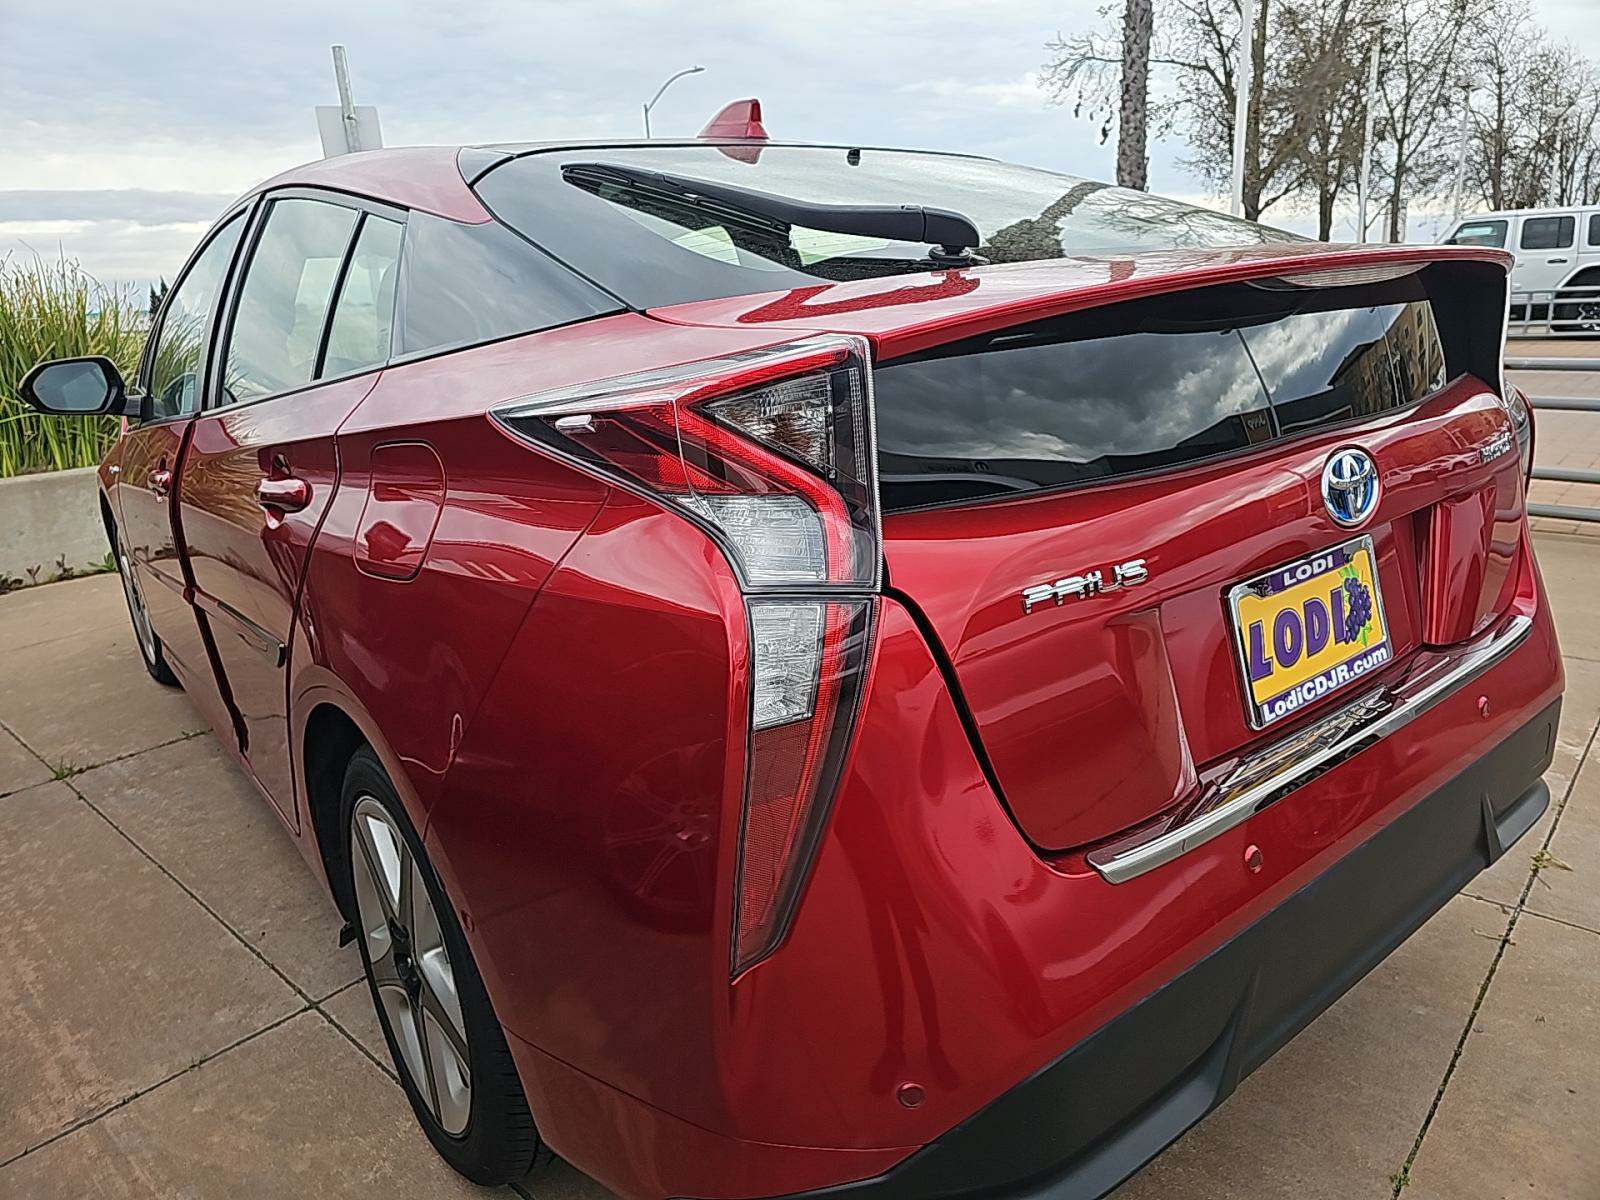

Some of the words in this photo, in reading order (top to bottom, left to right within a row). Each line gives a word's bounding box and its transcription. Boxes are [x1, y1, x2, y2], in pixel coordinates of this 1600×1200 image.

[1022, 558, 1148, 614] PRIUS
[1283, 554, 1334, 586] LODI
[1249, 586, 1347, 681] LODI
[1262, 647, 1388, 723] LodiCDJR.com
